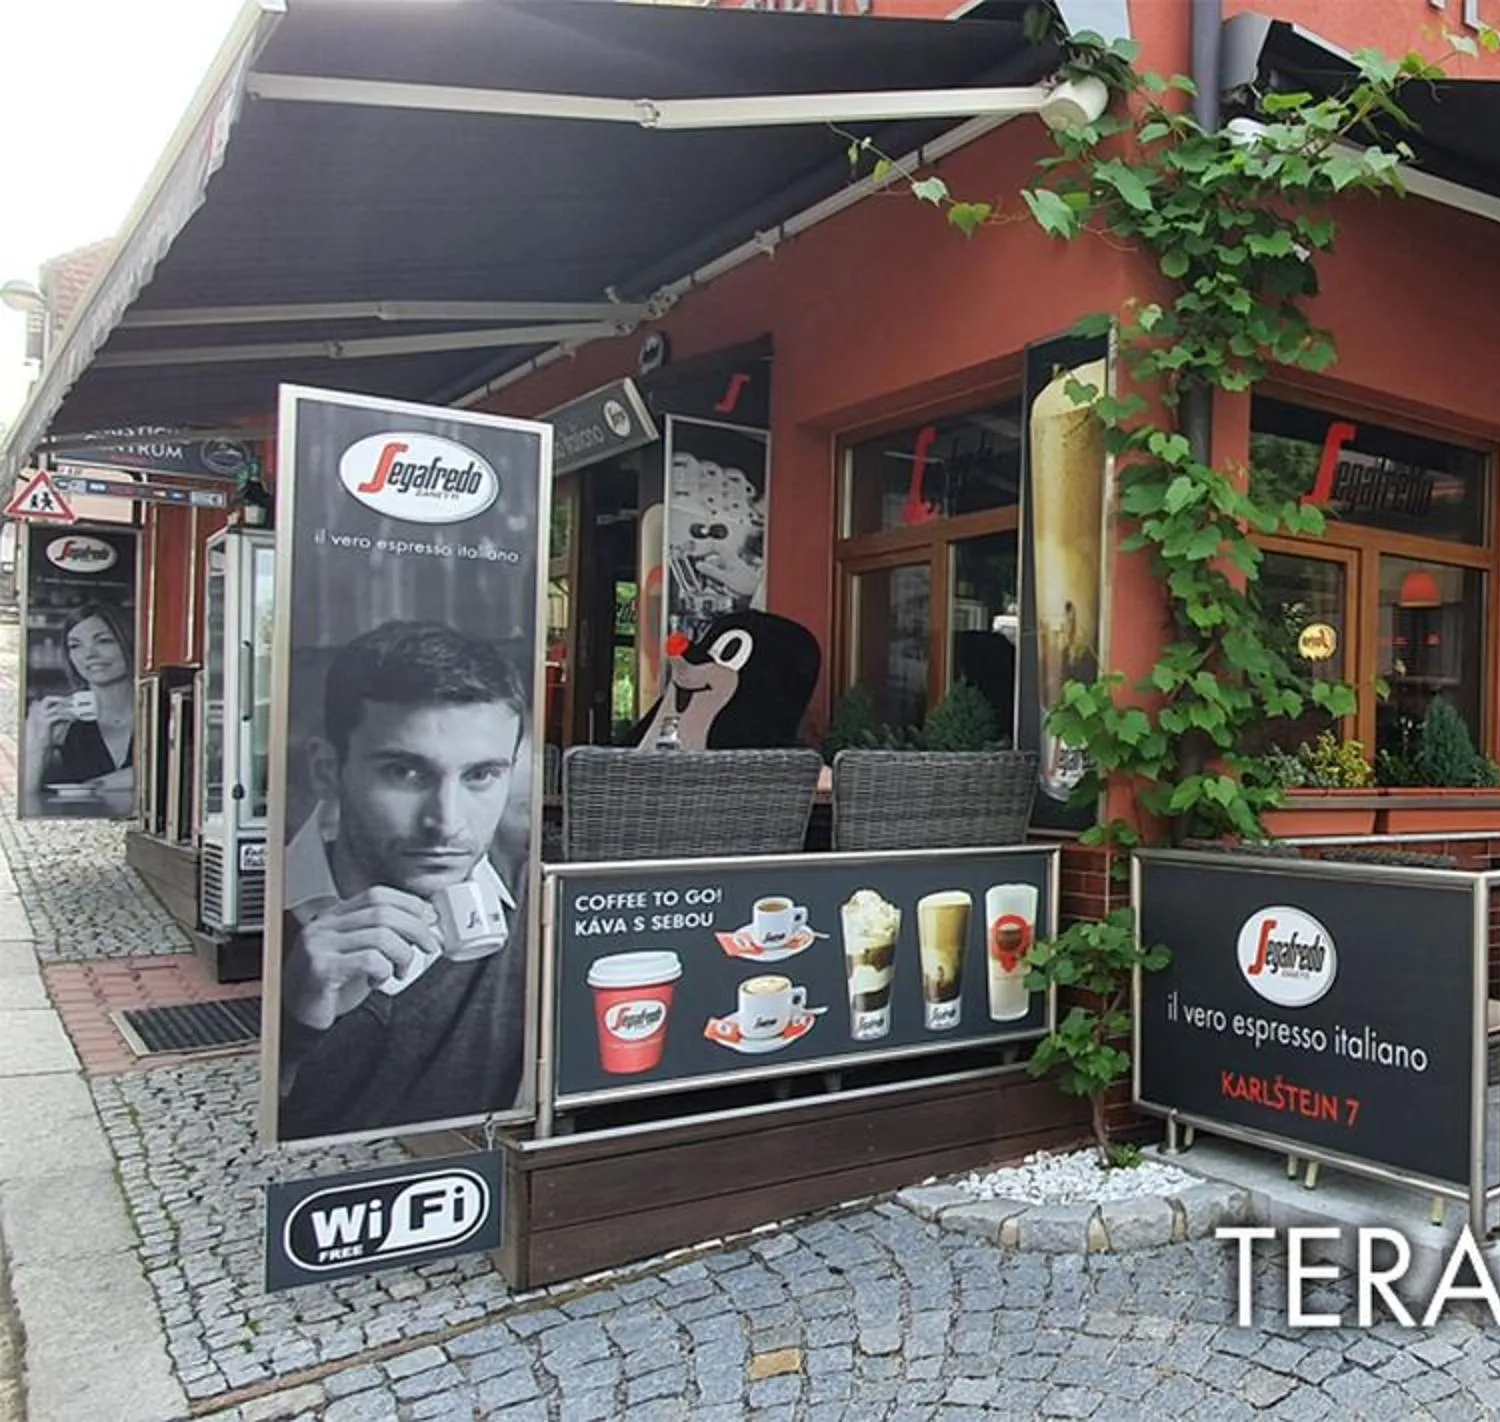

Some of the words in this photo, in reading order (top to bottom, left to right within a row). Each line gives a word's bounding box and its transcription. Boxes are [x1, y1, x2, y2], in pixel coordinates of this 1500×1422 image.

[358, 442, 483, 495] Segafredo
[314, 529, 325, 545] il
[331, 534, 371, 549] vero
[377, 540, 452, 558] espresso
[575, 892, 647, 912] COFFEE
[653, 890, 678, 907] TO
[685, 888, 722, 905] GO!
[575, 914, 628, 936] KÁVA
[633, 916, 646, 932] S
[652, 912, 713, 931] SEBOU
[1248, 920, 1325, 974] Segafredo
[1168, 991, 1178, 1021] il
[1184, 1004, 1227, 1032] vero
[1233, 1014, 1327, 1052] espresso
[1335, 1025, 1428, 1072] italiano
[1221, 1069, 1338, 1121] KARLŠTEJN
[1346, 1098, 1359, 1127] 7
[319, 1244, 363, 1263] FREE
